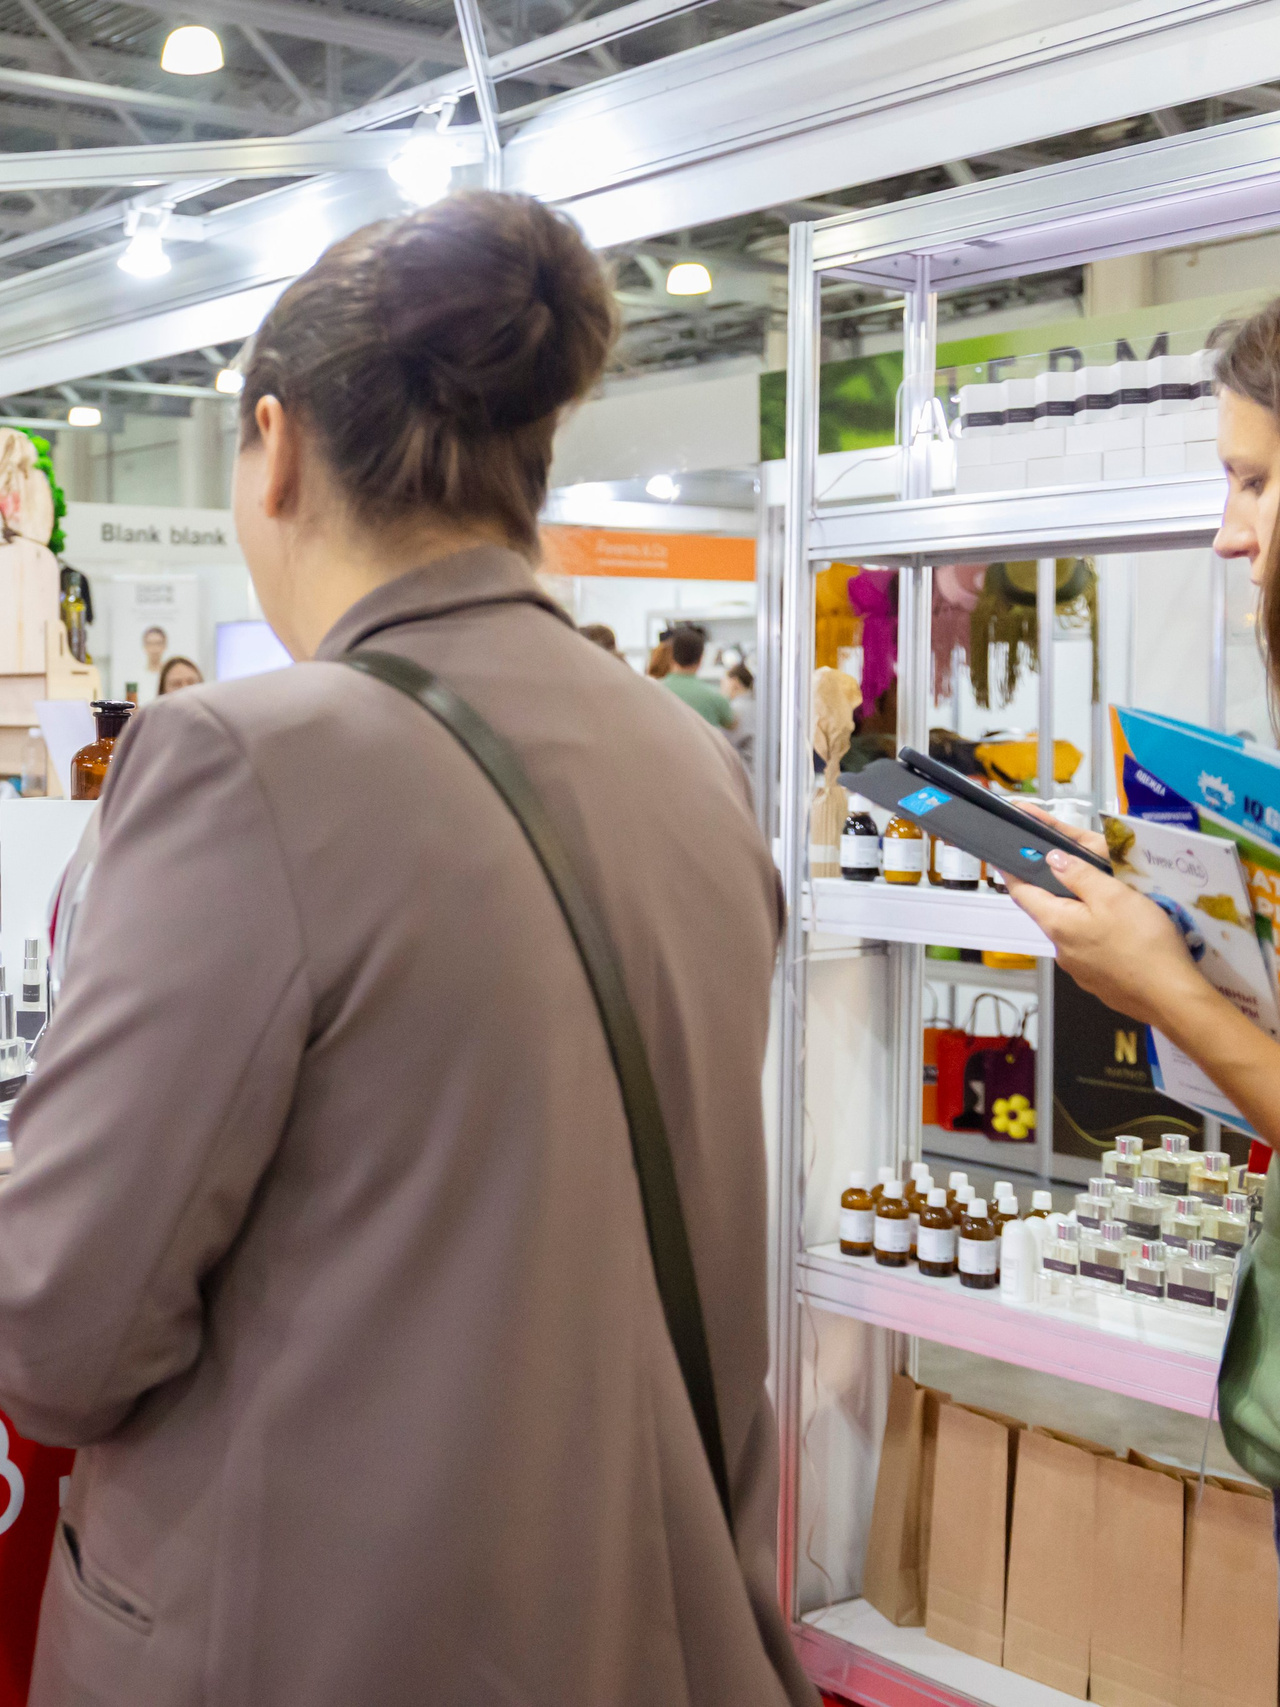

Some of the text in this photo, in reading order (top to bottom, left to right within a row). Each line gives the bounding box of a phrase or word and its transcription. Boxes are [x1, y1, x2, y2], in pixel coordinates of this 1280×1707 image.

[101, 521, 227, 546] Blank blank
[1114, 1028, 1138, 1065] N
